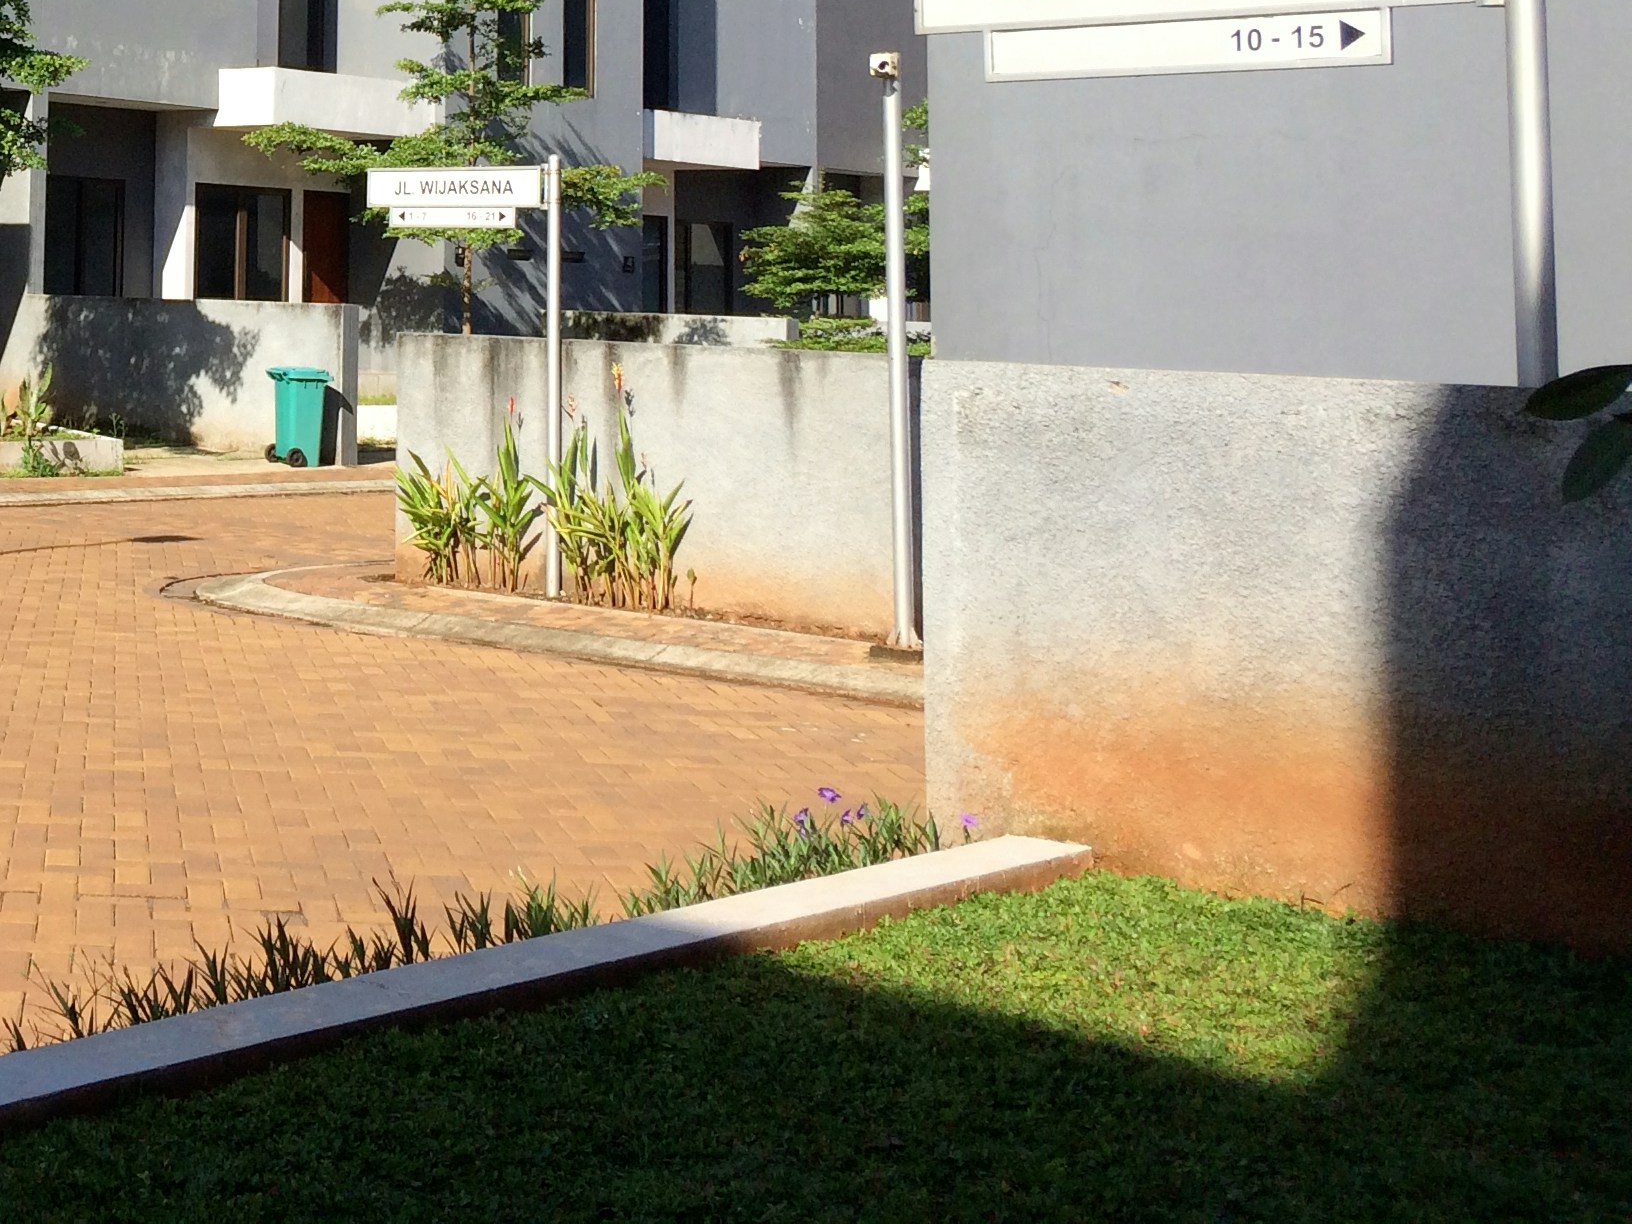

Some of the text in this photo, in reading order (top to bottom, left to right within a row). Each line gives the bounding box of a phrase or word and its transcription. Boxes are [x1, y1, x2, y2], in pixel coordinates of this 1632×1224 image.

[1230, 28, 1262, 52] 10
[1291, 25, 1324, 49] 15
[420, 180, 514, 195] WIJAKSANA
[467, 212, 477, 220] 16
[485, 212, 496, 220] 21
